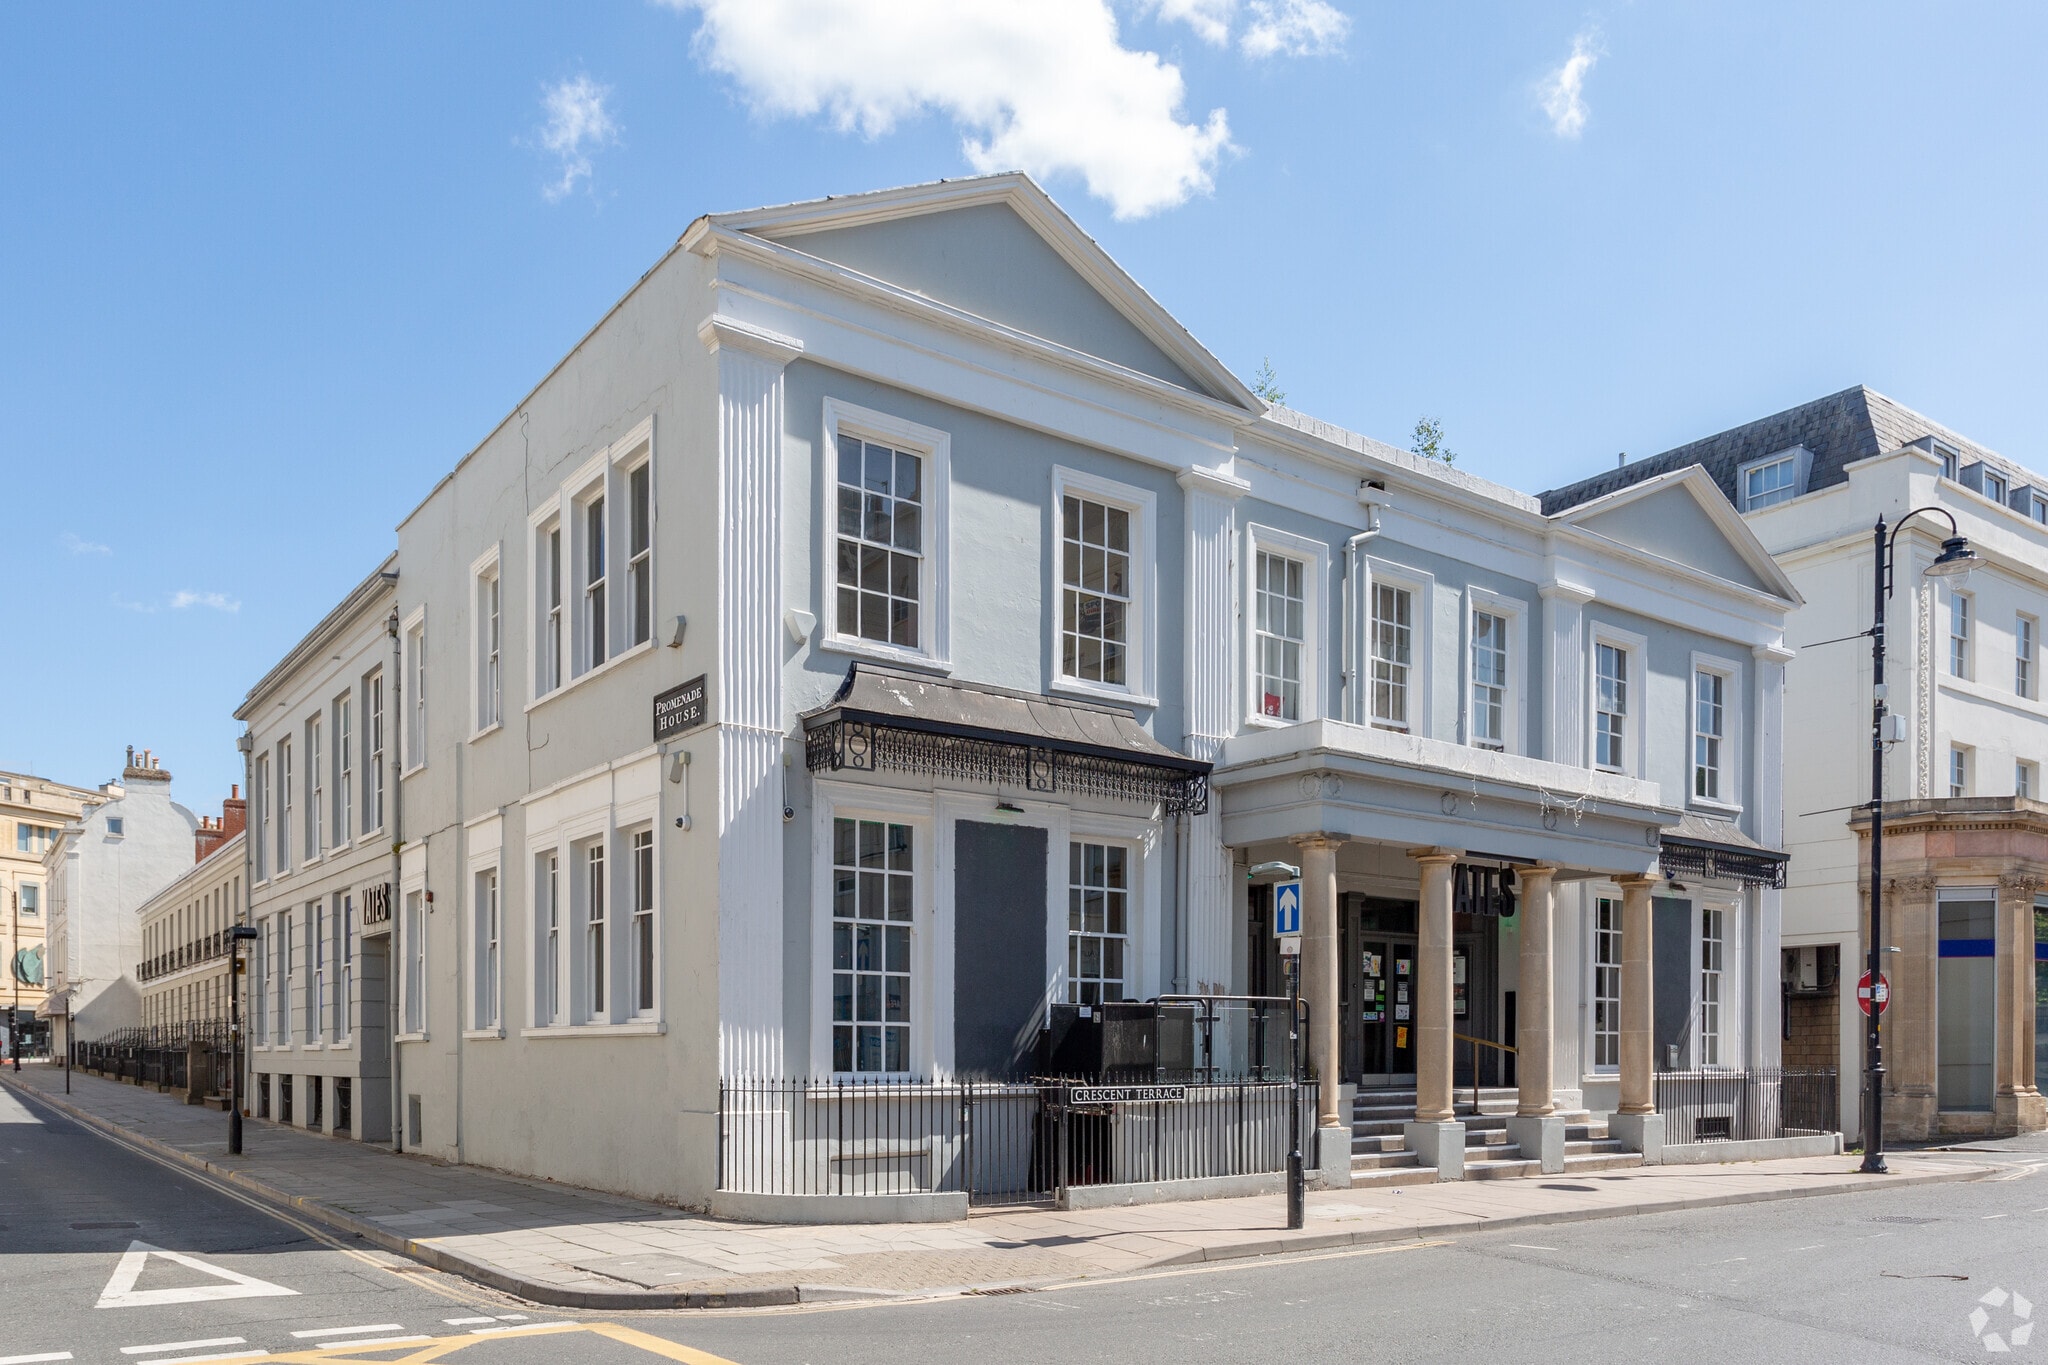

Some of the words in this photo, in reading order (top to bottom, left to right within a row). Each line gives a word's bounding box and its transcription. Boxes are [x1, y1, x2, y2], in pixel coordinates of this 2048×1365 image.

[655, 687, 702, 716] PROMENADE
[362, 883, 389, 925] YATES
[1452, 863, 1515, 917] ATES
[1075, 1089, 1131, 1101] CRESCENT
[1136, 1088, 1182, 1100] TERRACE
